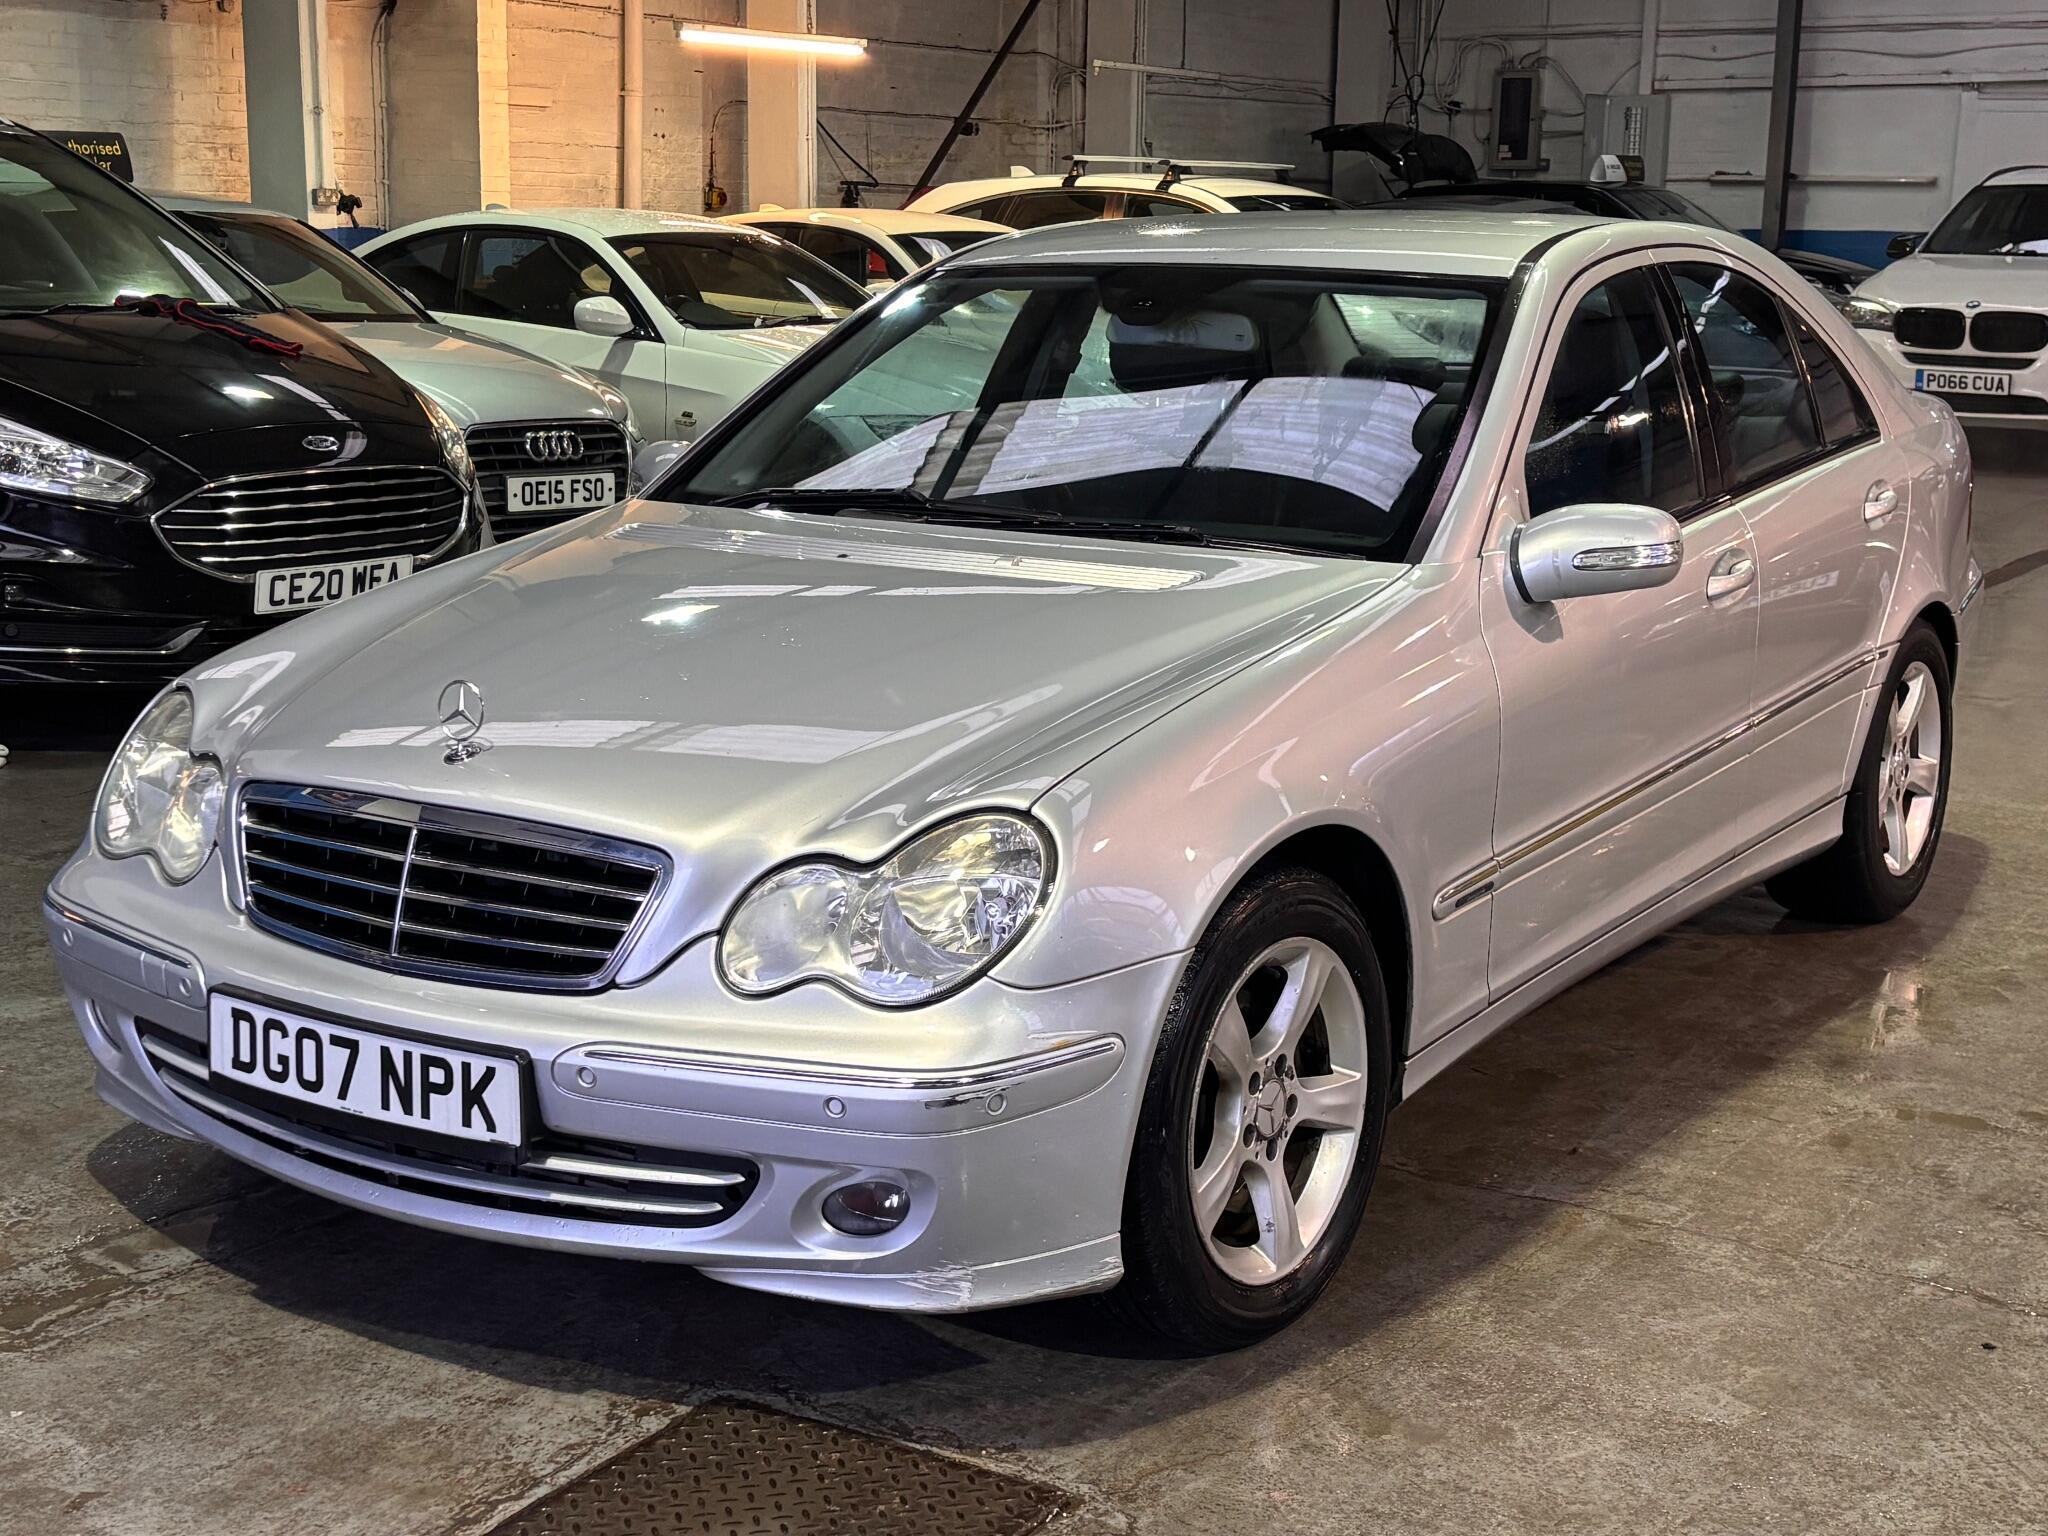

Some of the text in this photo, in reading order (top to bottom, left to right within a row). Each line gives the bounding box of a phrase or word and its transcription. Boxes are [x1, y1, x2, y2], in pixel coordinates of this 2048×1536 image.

[1926, 373, 1968, 390] PO66
[1972, 376, 2005, 392] CUA
[521, 478, 604, 506] OE15 FSO
[269, 569, 343, 606] CE20
[231, 1006, 497, 1133] DG07 NPK
